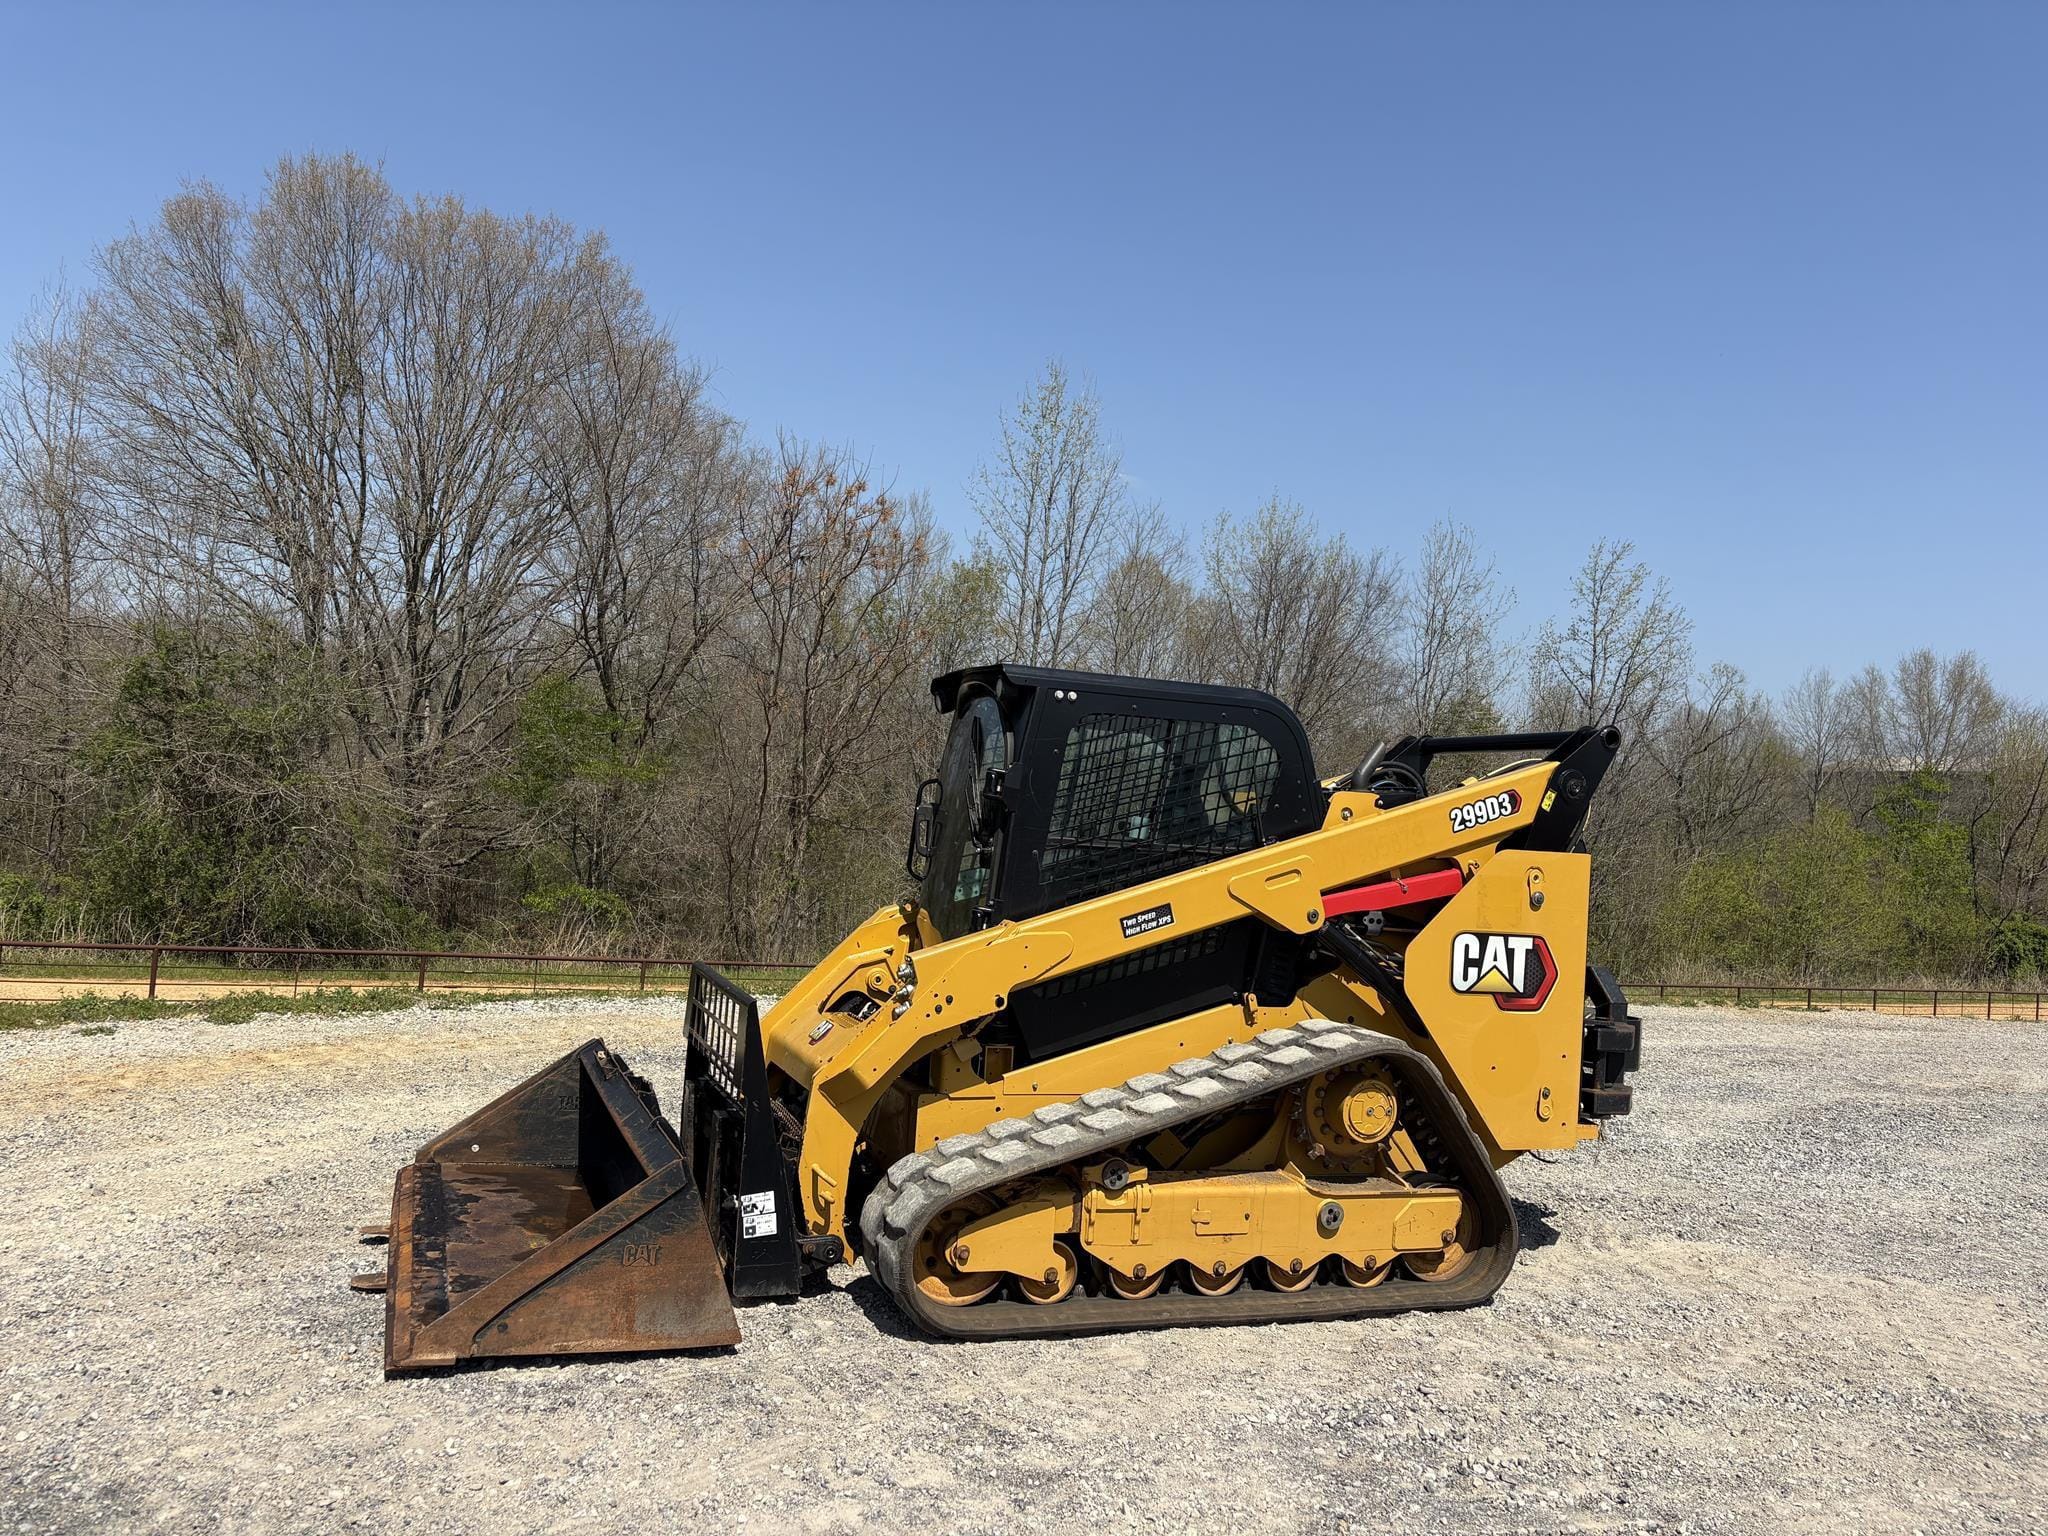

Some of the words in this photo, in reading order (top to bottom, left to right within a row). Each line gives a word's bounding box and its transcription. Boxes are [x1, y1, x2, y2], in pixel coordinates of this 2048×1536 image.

[1450, 792, 1512, 832] 299D3
[1158, 915, 1171, 926] XPS
[1452, 933, 1534, 993] CAT
[622, 1244, 659, 1267] CAT
